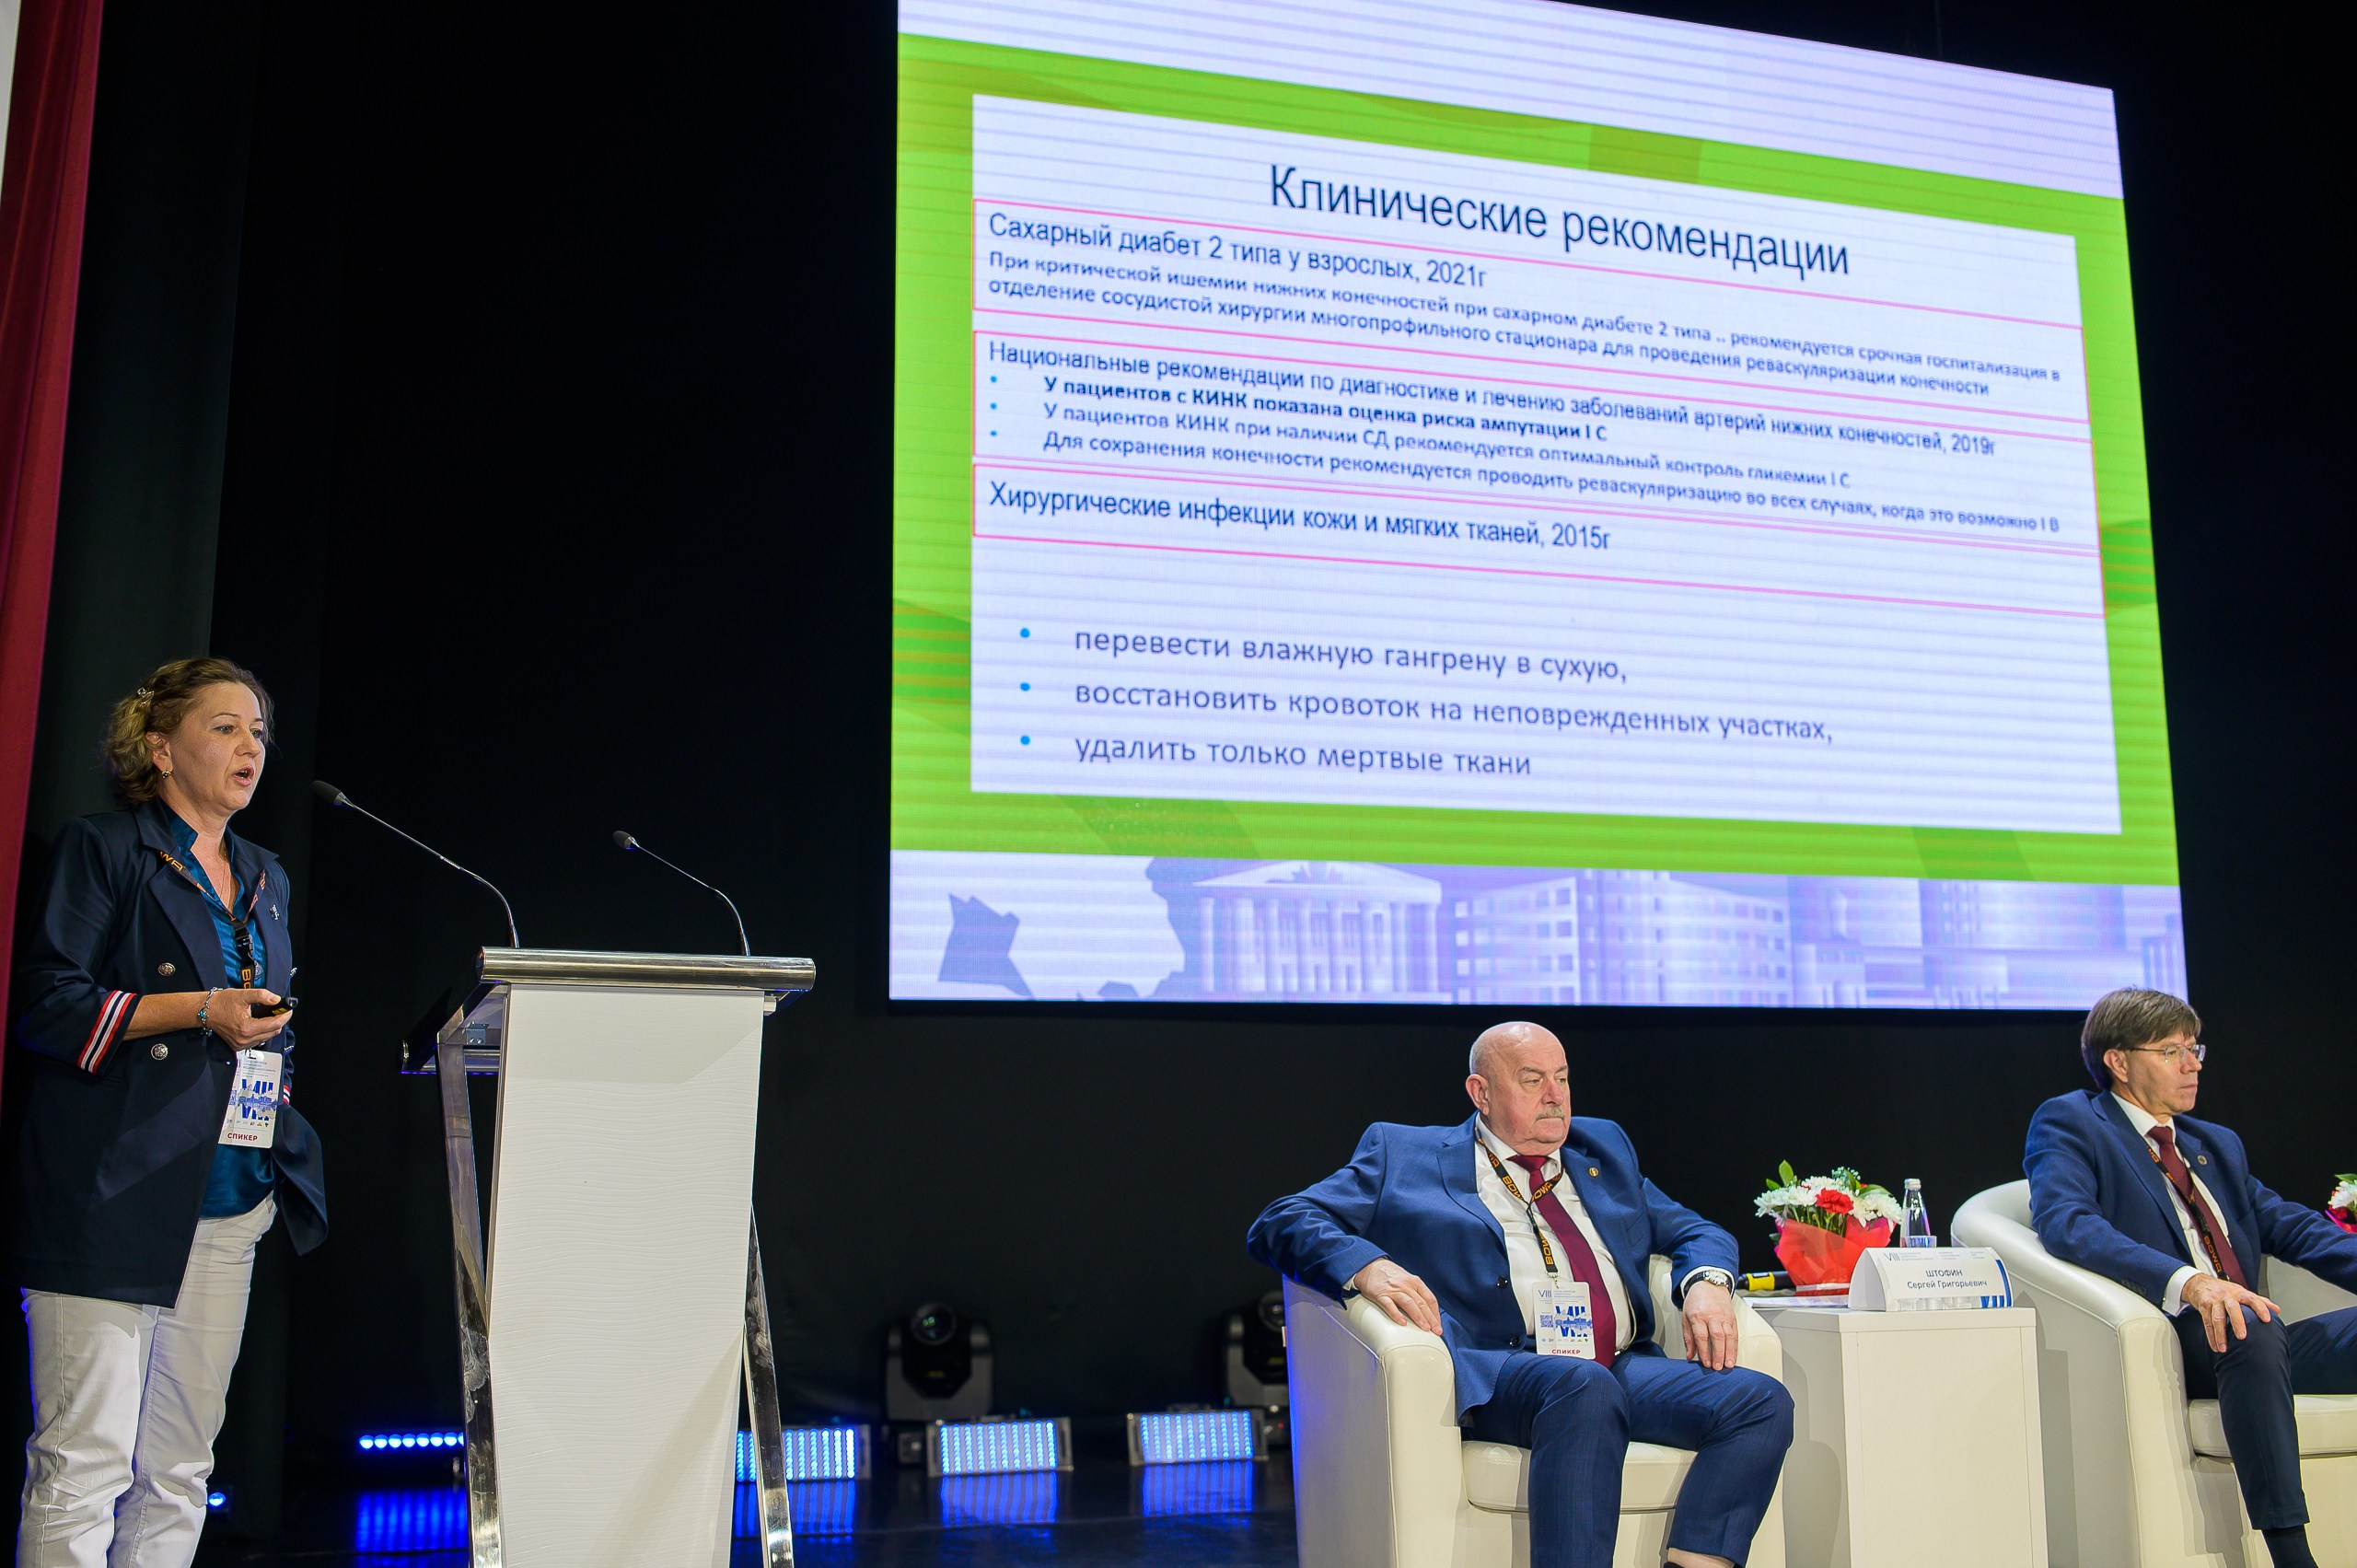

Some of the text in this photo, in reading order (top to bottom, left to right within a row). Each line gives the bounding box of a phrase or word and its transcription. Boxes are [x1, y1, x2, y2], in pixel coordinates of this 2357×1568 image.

[989, 212, 1112, 248] Сахарный
[1118, 230, 1201, 256] диабет
[1231, 243, 1282, 265] типа
[1307, 251, 1419, 282] взрослых,
[1426, 259, 1485, 287] 2021г
[1271, 163, 1849, 282] Клинические рекомендации
[989, 280, 1989, 395] отделение сосудистой хирургии многопрофильного стационара для проведения реваскуляризации конечности
[990, 250, 1029, 270] При
[1035, 260, 1161, 282] критической
[1167, 273, 1248, 291] ишемии
[1253, 282, 1326, 299] нижних
[1332, 289, 1449, 312] конечностей
[1455, 302, 1488, 319] при
[1492, 307, 1578, 326] сахарном
[1581, 315, 1654, 335] диабете
[1674, 326, 1712, 341] типа
[1731, 332, 1854, 357] рекомендуется
[1858, 347, 1922, 365] срочная
[1926, 355, 2048, 379] госпитализация
[990, 341, 1150, 374] Национальные
[1156, 361, 1305, 390] рекомендации
[1310, 375, 1334, 391] по
[1339, 378, 1459, 402] диагностике
[1483, 391, 1565, 412] лечению
[1571, 396, 1689, 424] заболеваний
[1694, 412, 1766, 434] артерий
[1771, 420, 1833, 438] нижних
[1839, 427, 1946, 452] конечностей,
[1951, 433, 1994, 455] 2019г
[1063, 381, 1172, 401] пациентов
[1192, 388, 1248, 409] КИНК
[1253, 398, 1343, 417] показана
[1348, 406, 1417, 424] оценка
[1422, 412, 1476, 428] риска
[1480, 418, 1581, 439] ампутации
[1042, 431, 1083, 452] Для
[1089, 437, 1205, 459] сохранения
[1212, 447, 1324, 468] конечности
[1329, 457, 1472, 482] рекомендуется
[1478, 469, 1573, 489] проводить
[1578, 478, 1742, 504] реваскуляризацию
[1747, 492, 1767, 505] во
[1771, 494, 1806, 509] всех
[1810, 498, 1877, 517] случаях,
[1881, 505, 1925, 521] когда
[1930, 509, 1955, 523] это
[1957, 512, 2038, 530] возможно
[1063, 408, 1169, 428] пациентов
[1176, 413, 1229, 433] КИНК
[1235, 422, 1271, 438] при
[1276, 426, 1358, 443] наличии
[1363, 428, 1390, 450] СД
[1395, 436, 1534, 459] рекомендуется
[1538, 448, 1660, 470] оптимальный
[1666, 460, 1744, 478] контроль
[1747, 467, 1827, 484] гликемии
[990, 481, 1171, 517] Хирургические
[1178, 497, 1295, 530] инфекции
[1303, 510, 1357, 530] кожи
[1386, 516, 1459, 539] мягких
[1467, 521, 1545, 547] тканей,
[1551, 522, 1609, 550] 2015г
[1075, 632, 1229, 658] перевести
[1243, 641, 1374, 669] влажную
[1385, 648, 1506, 679] гангрену
[1540, 657, 1627, 683] сухую,
[1075, 684, 1832, 744] восстановить кровоток на неповрежденных участках,
[1075, 738, 1530, 775] удалить только мертвые ткани
[227, 1132, 258, 1142] СПИКЕР
[1907, 1280, 1988, 1290] Сергей Григорьевич
[1925, 1269, 1963, 1278] ШТОФИН
